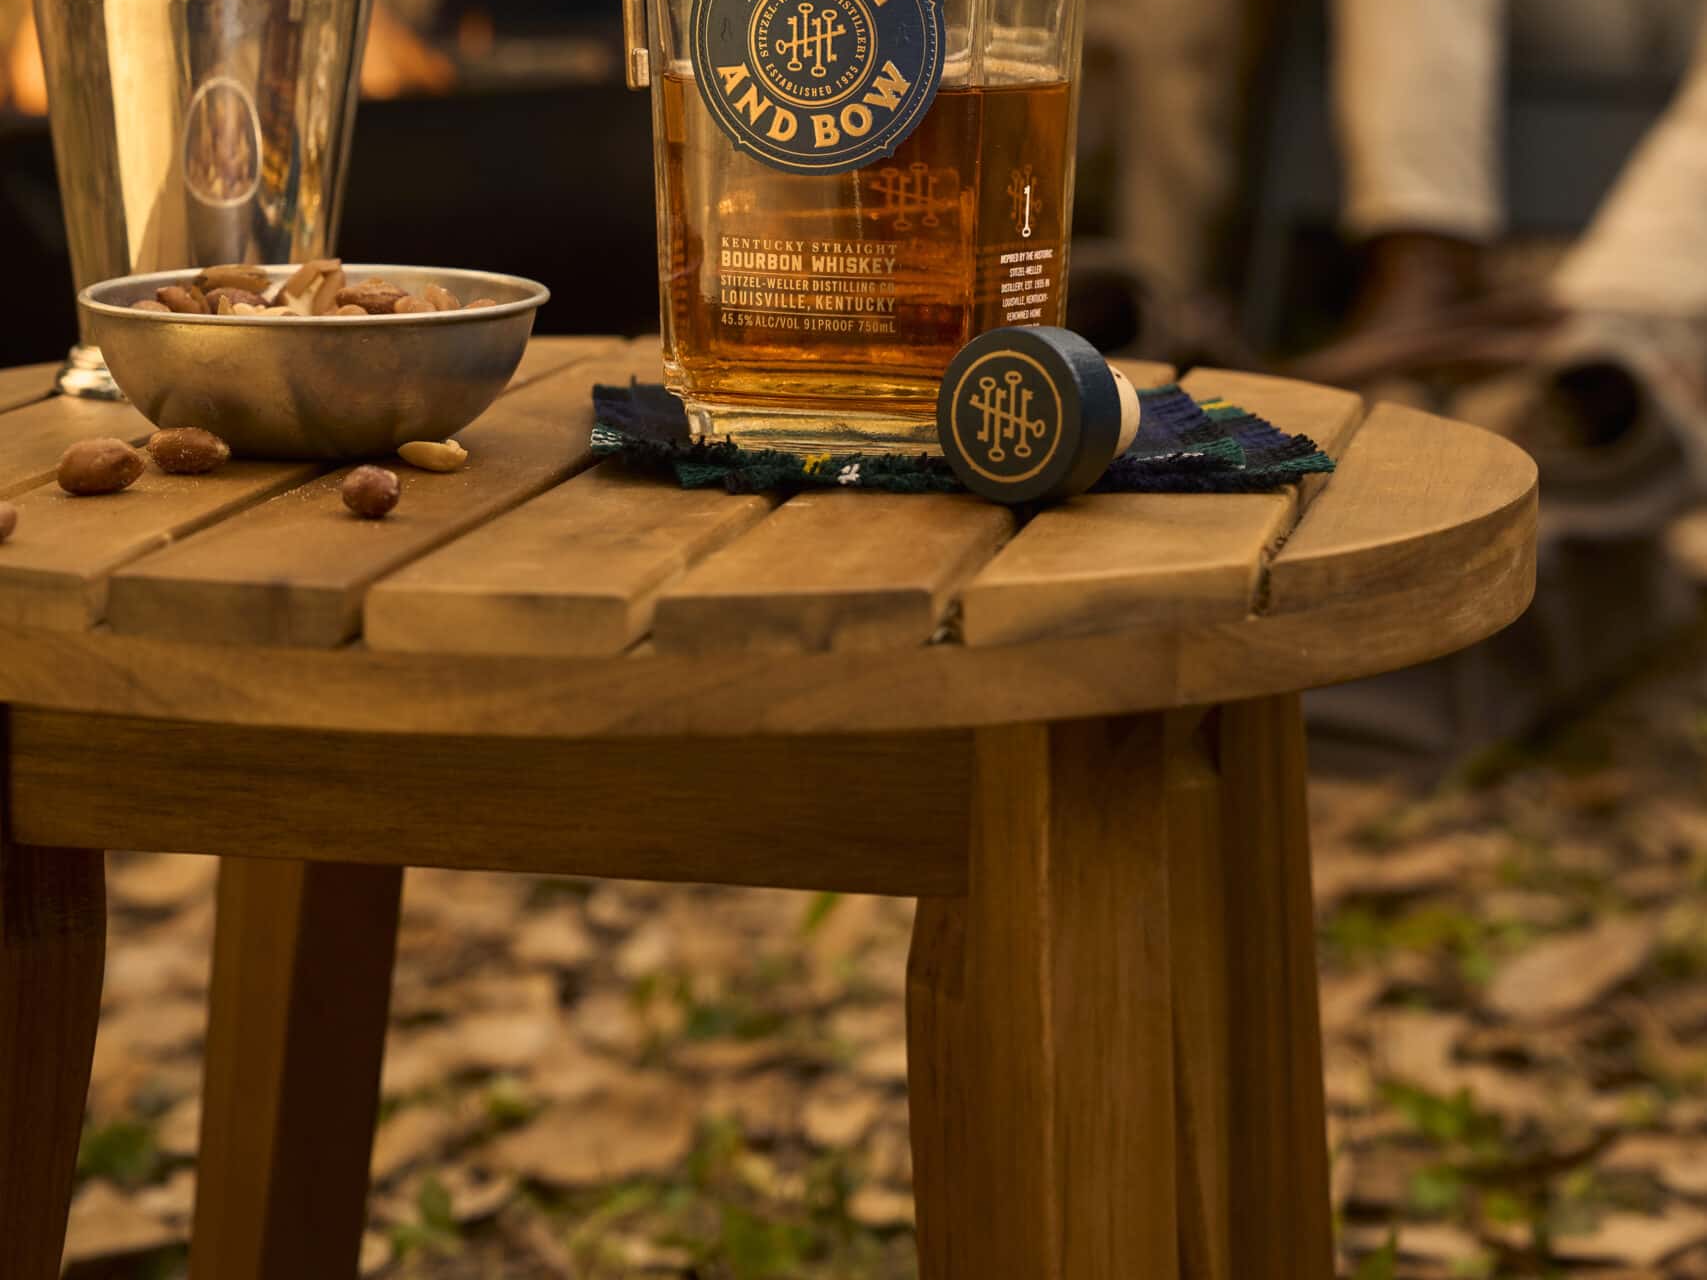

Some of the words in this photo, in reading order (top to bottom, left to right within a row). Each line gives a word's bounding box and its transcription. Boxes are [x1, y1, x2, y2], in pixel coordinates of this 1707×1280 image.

[766, 63, 832, 97] ESTABLISHED
[836, 65, 859, 89] 1935
[716, 62, 798, 142] AND
[810, 60, 911, 148] BOW
[721, 237, 804, 252] KENTUCKY
[811, 242, 897, 255] STRAIGHT
[721, 250, 803, 271] BOURBON
[811, 255, 896, 274] WHISKEY
[720, 275, 809, 291] STITZEL-WELLER
[812, 279, 876, 293] DISTILLING
[721, 289, 811, 311] LOUISVILLE,
[815, 295, 896, 313] KENTUCKY
[858, 320, 896, 333] 750mL
